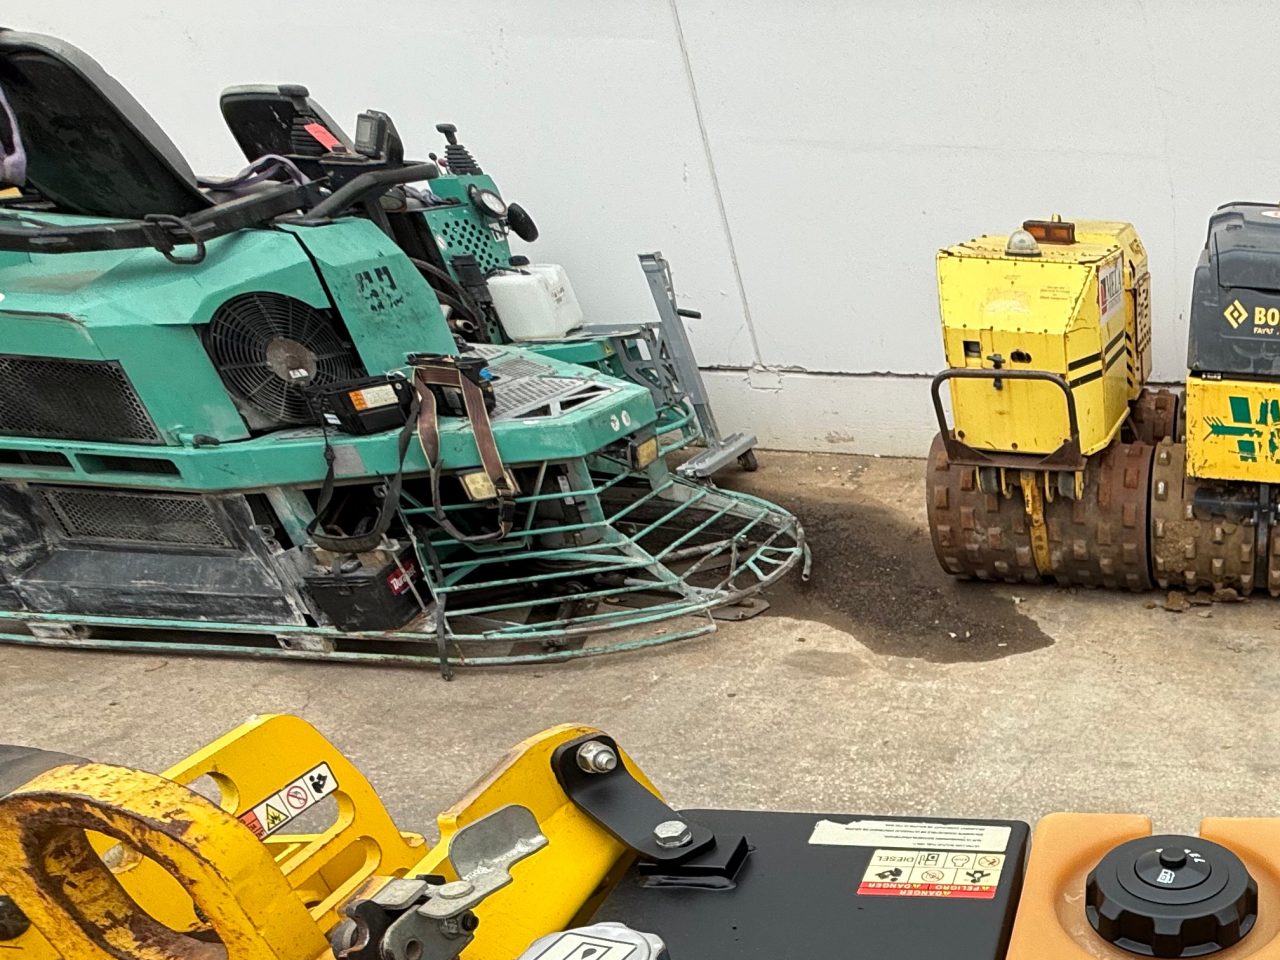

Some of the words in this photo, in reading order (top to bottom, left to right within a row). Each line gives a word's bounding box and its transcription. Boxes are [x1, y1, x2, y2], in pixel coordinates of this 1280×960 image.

[876, 855, 915, 863] DIESEL
[934, 884, 981, 892] PELIGRO
[899, 889, 943, 897] DANGER
